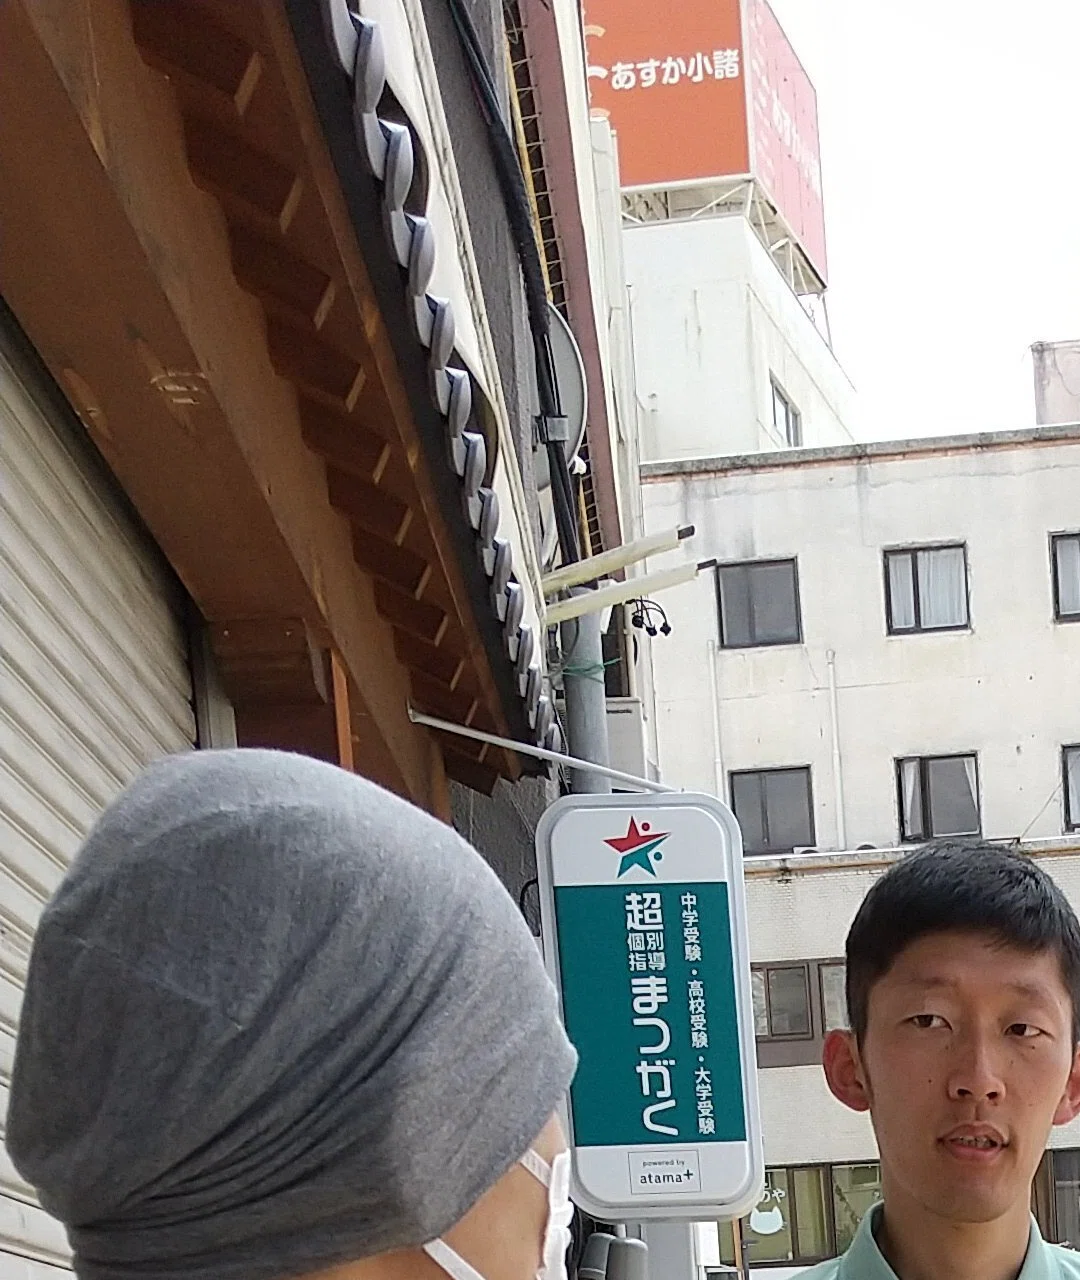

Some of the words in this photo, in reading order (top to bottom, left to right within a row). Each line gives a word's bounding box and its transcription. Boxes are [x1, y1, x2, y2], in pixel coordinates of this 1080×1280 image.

[611, 49, 739, 90] あすか小諸
[642, 1159, 675, 1167] powered
[676, 1158, 685, 1166] by
[639, 1169, 694, 1185] atama+
